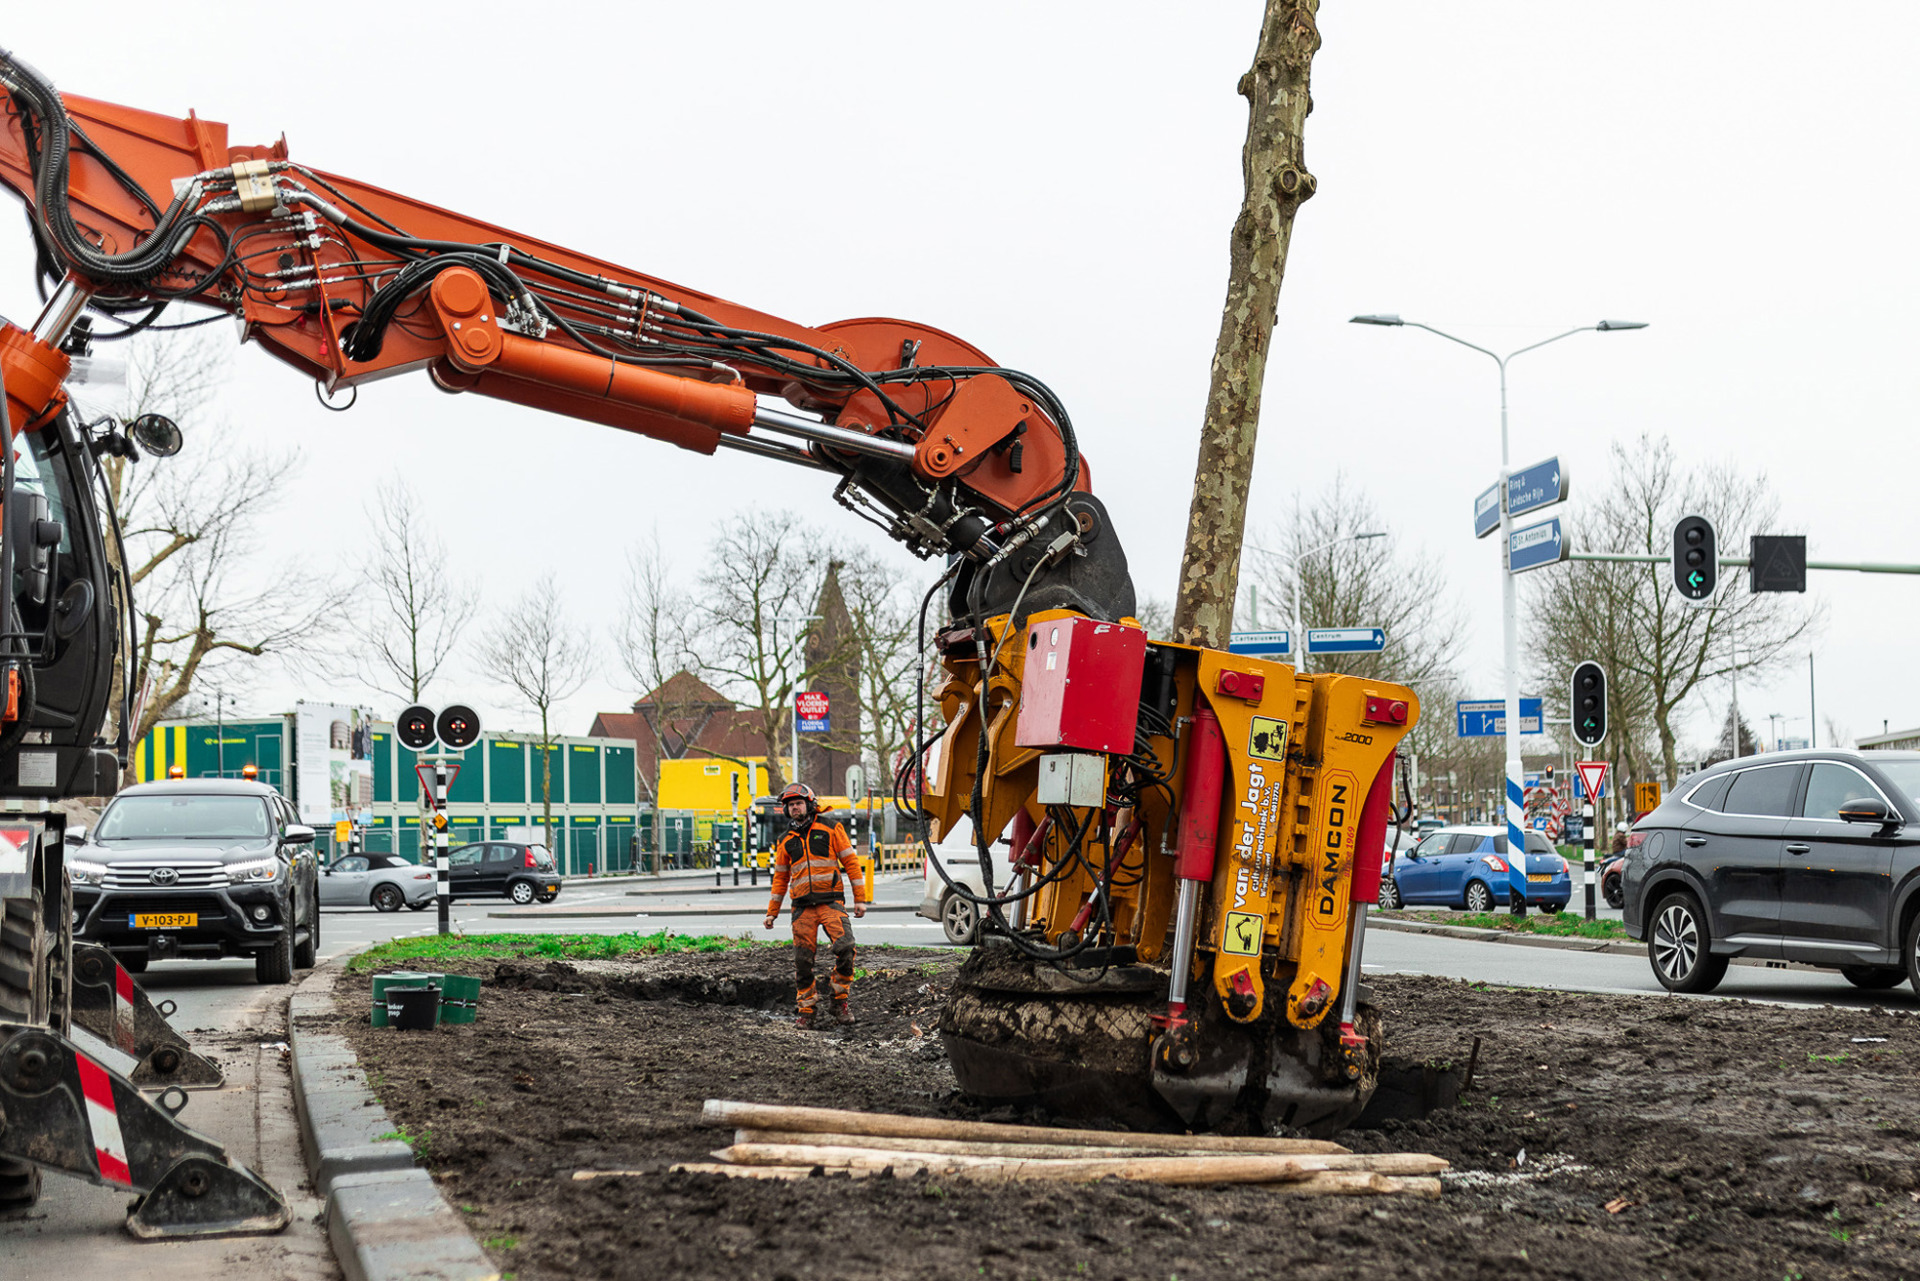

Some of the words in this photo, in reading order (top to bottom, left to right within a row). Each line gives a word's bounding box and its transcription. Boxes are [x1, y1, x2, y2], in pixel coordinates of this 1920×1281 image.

[1509, 479, 1521, 491] Ring
[1509, 491, 1532, 508] Leidsche
[1532, 487, 1544, 501] Rijn
[1525, 529, 1547, 541] Antonius
[1234, 634, 1282, 642] Cartesiusweg
[1241, 763, 1265, 815] Jagt
[1260, 786, 1272, 807] b.v.
[1235, 821, 1256, 860] der
[1346, 826, 1355, 850] 1969
[1319, 784, 1348, 915] DAMCON
[1233, 867, 1250, 909] van
[142, 915, 191, 926] V-103-PJ
